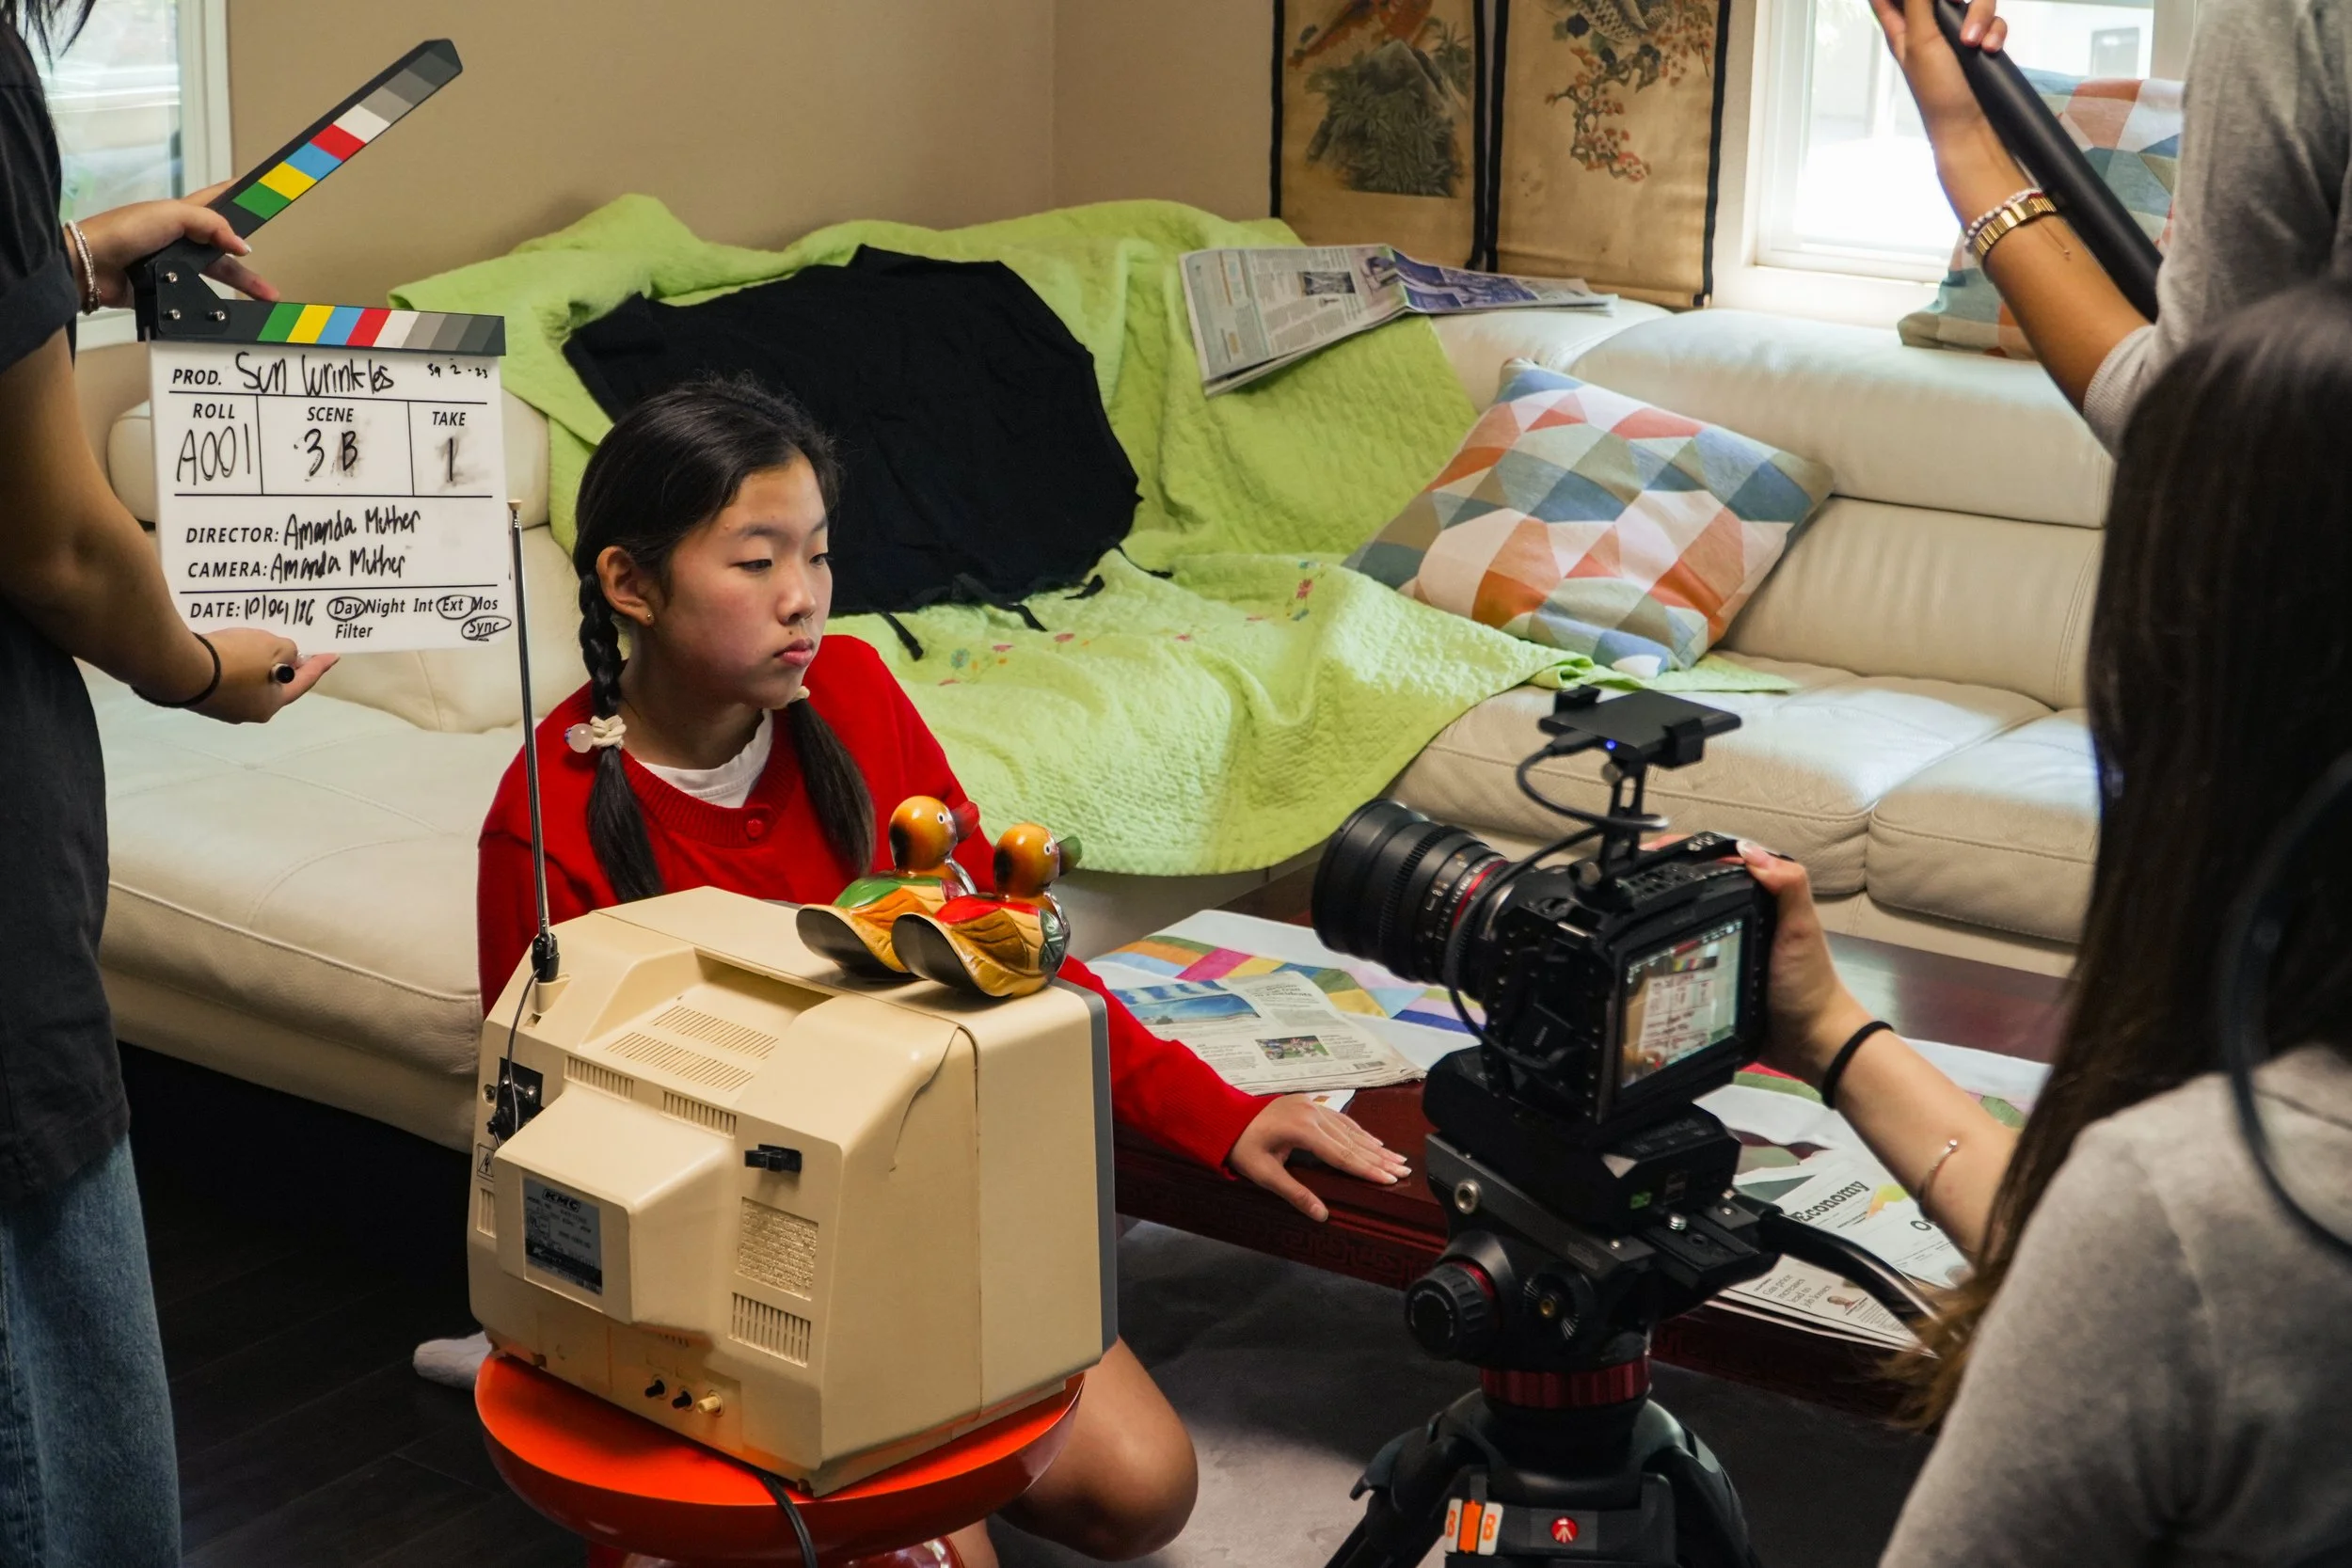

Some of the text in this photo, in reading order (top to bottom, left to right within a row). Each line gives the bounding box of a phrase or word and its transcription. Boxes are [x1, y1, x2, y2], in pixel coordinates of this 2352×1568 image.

[172, 369, 222, 386] PROD.
[235, 351, 287, 395] Sun
[193, 403, 235, 420] ROLL
[307, 406, 354, 422] SCENE
[432, 411, 467, 427] TAKE
[304, 428, 358, 477] 3 B
[185, 527, 278, 544] DIRECTOR:
[283, 510, 357, 550] Amanda
[187, 561, 268, 578] CAMERA:
[270, 550, 341, 584] Amanda
[190, 602, 241, 618] DATE:
[334, 596, 499, 617] Day Night Int Ext Mos
[335, 623, 373, 639] Filter
[469, 619, 499, 636] Sync
